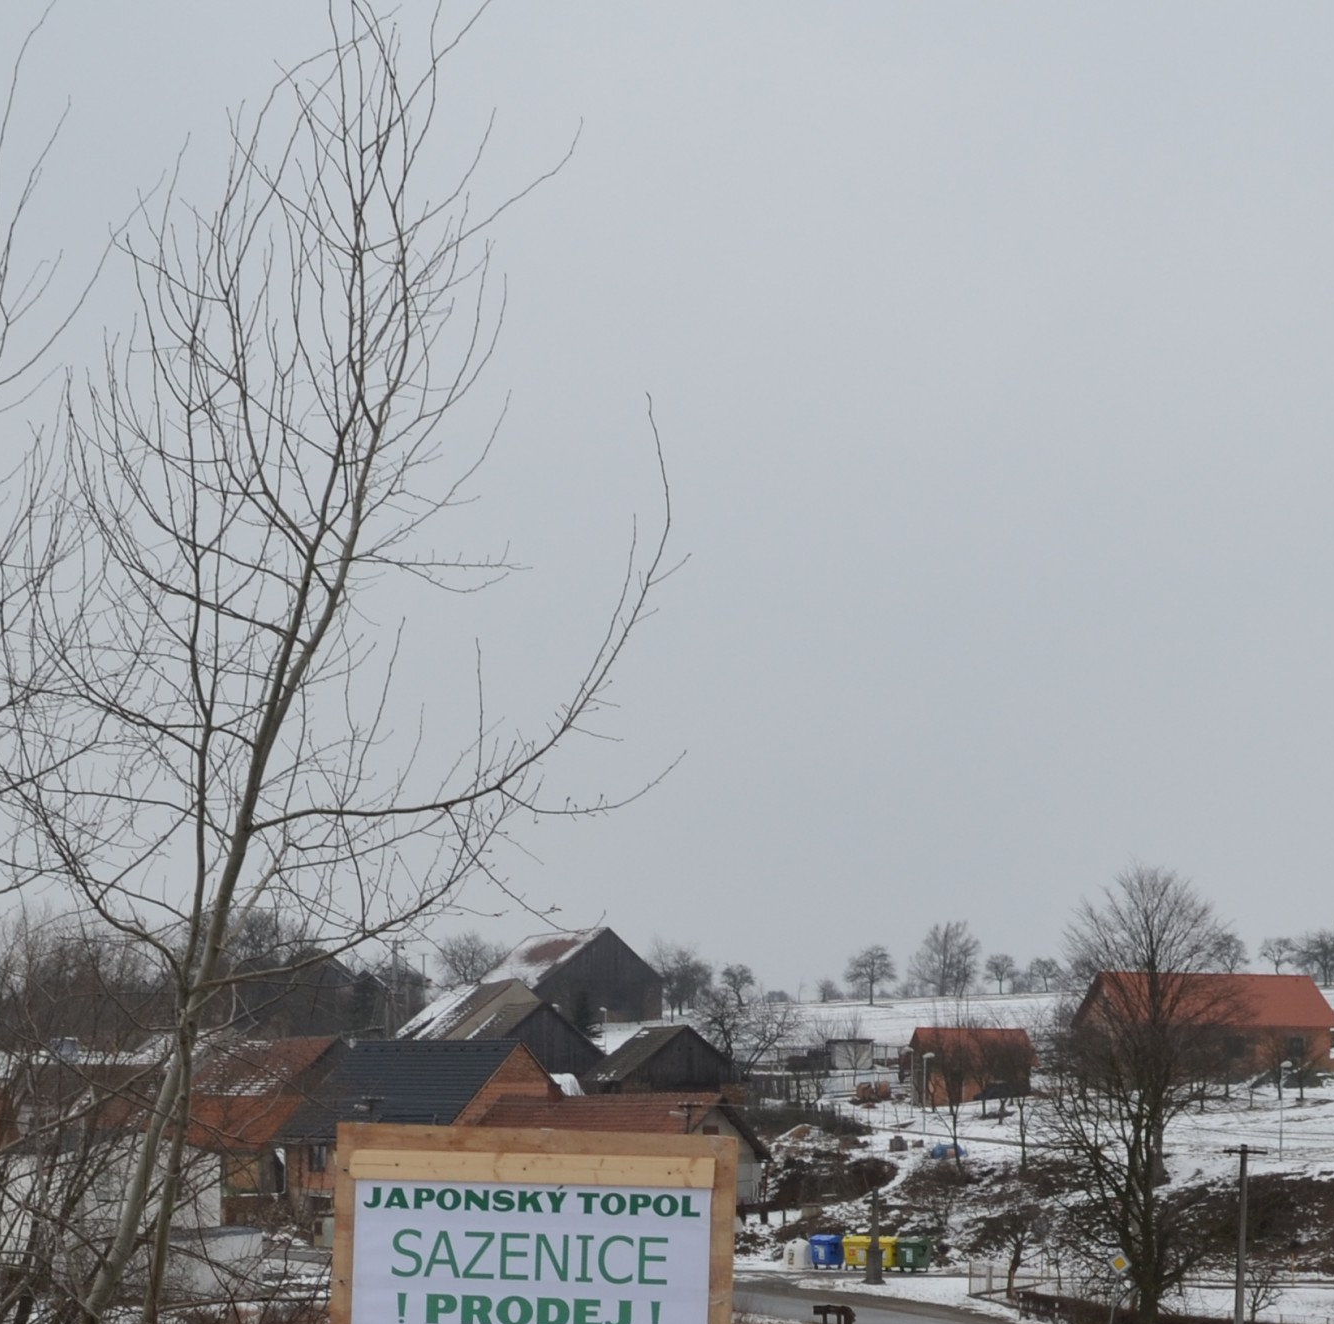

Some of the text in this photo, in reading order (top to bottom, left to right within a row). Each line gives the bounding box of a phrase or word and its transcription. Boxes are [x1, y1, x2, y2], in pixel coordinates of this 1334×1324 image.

[363, 1185, 701, 1218] JAPONSKÝ TOPOL
[391, 1228, 670, 1286] SAZENICE
